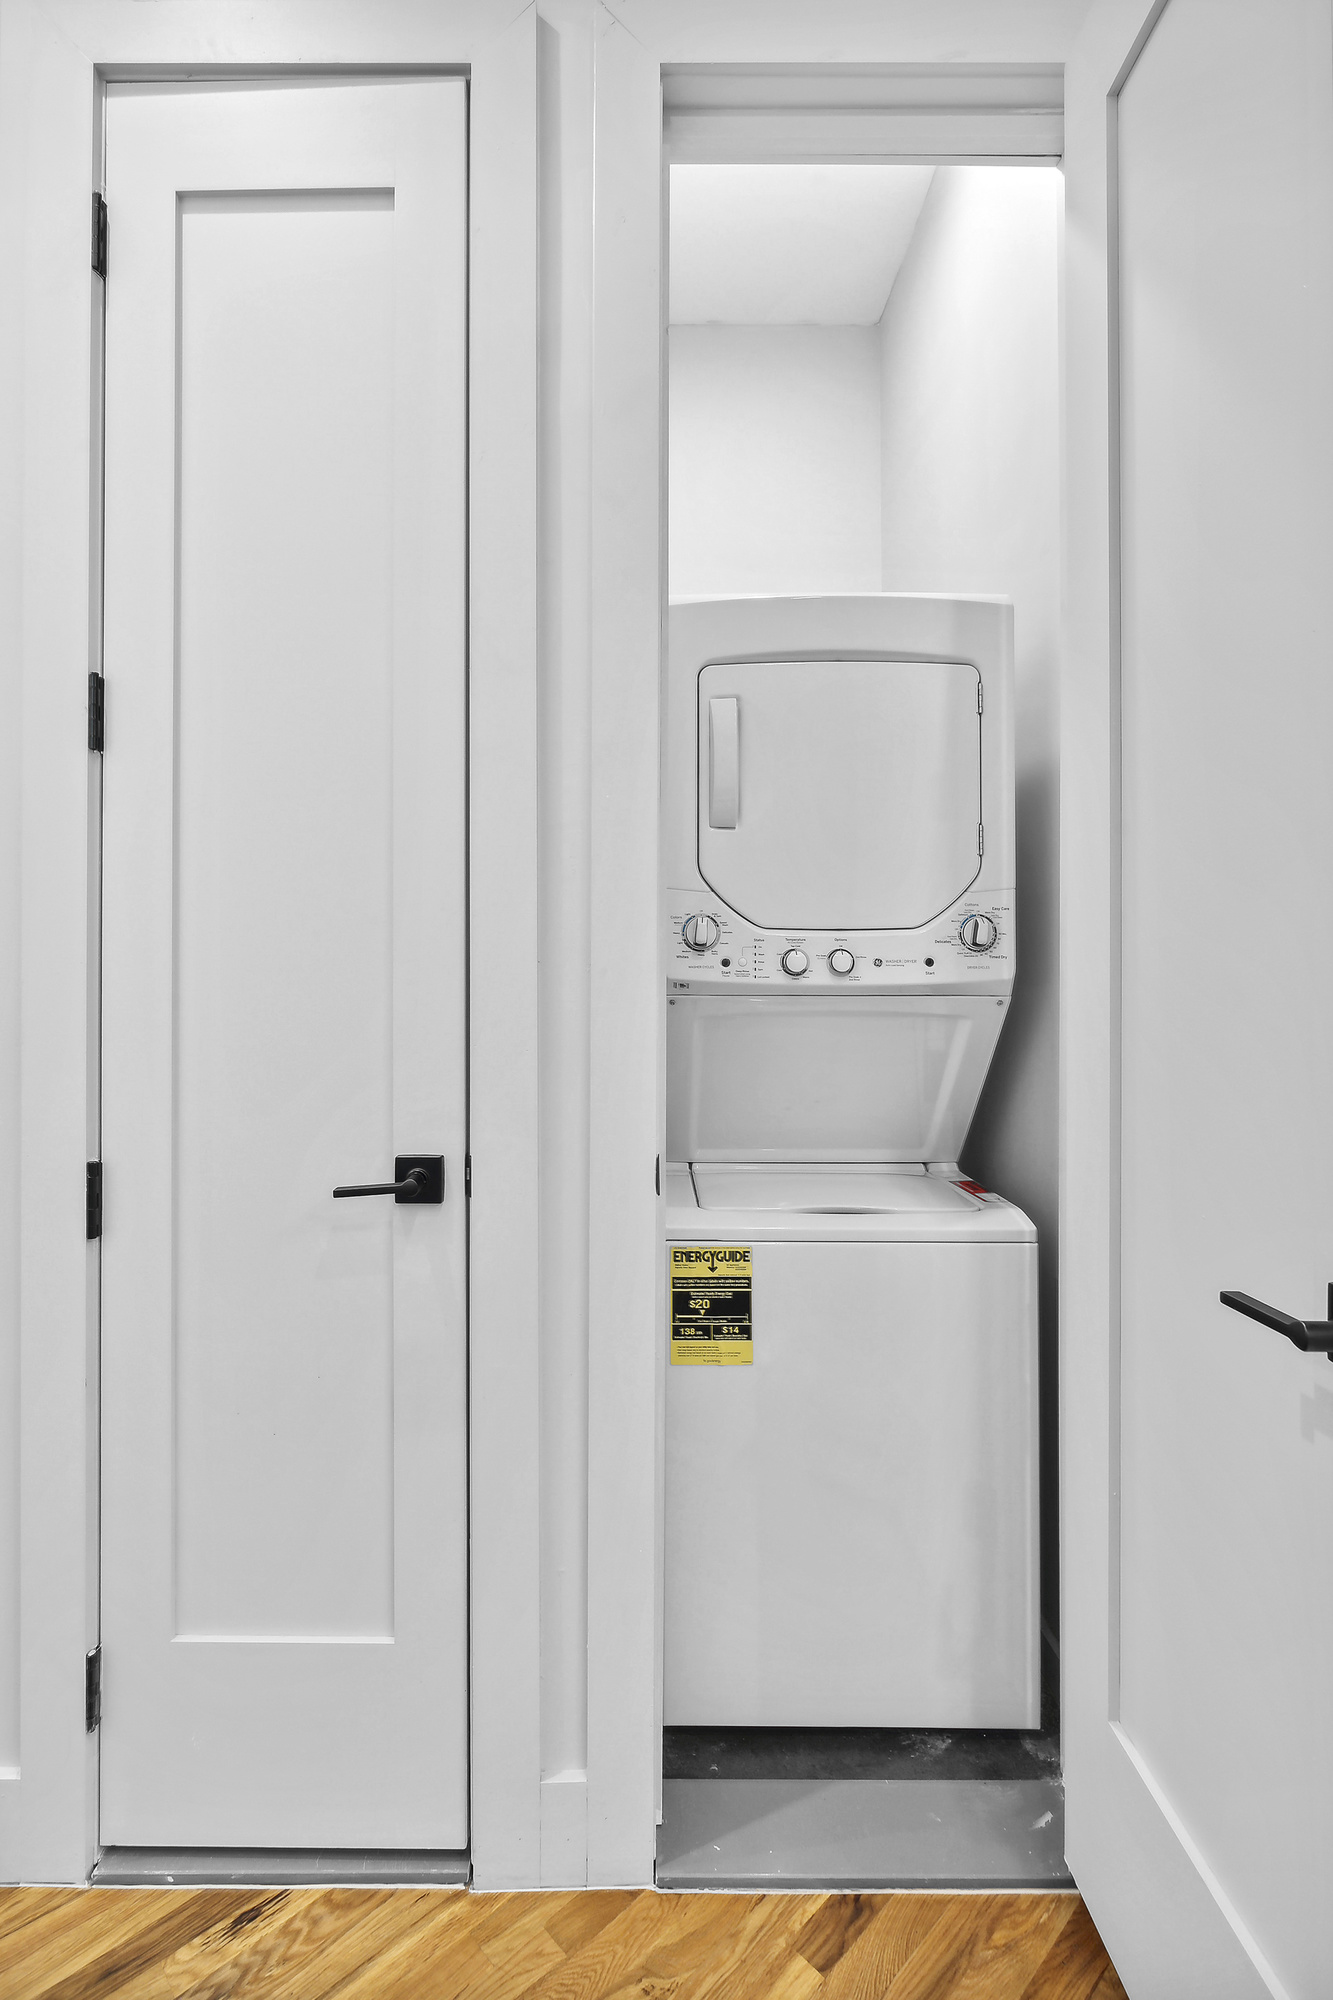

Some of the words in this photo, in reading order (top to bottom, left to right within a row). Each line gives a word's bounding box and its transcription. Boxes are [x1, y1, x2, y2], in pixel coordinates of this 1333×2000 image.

[673, 1250, 751, 1263] ENERGYGUIDE
[689, 1299, 711, 1309] $20
[679, 1327, 696, 1336] 138
[722, 1326, 740, 1334] $14
